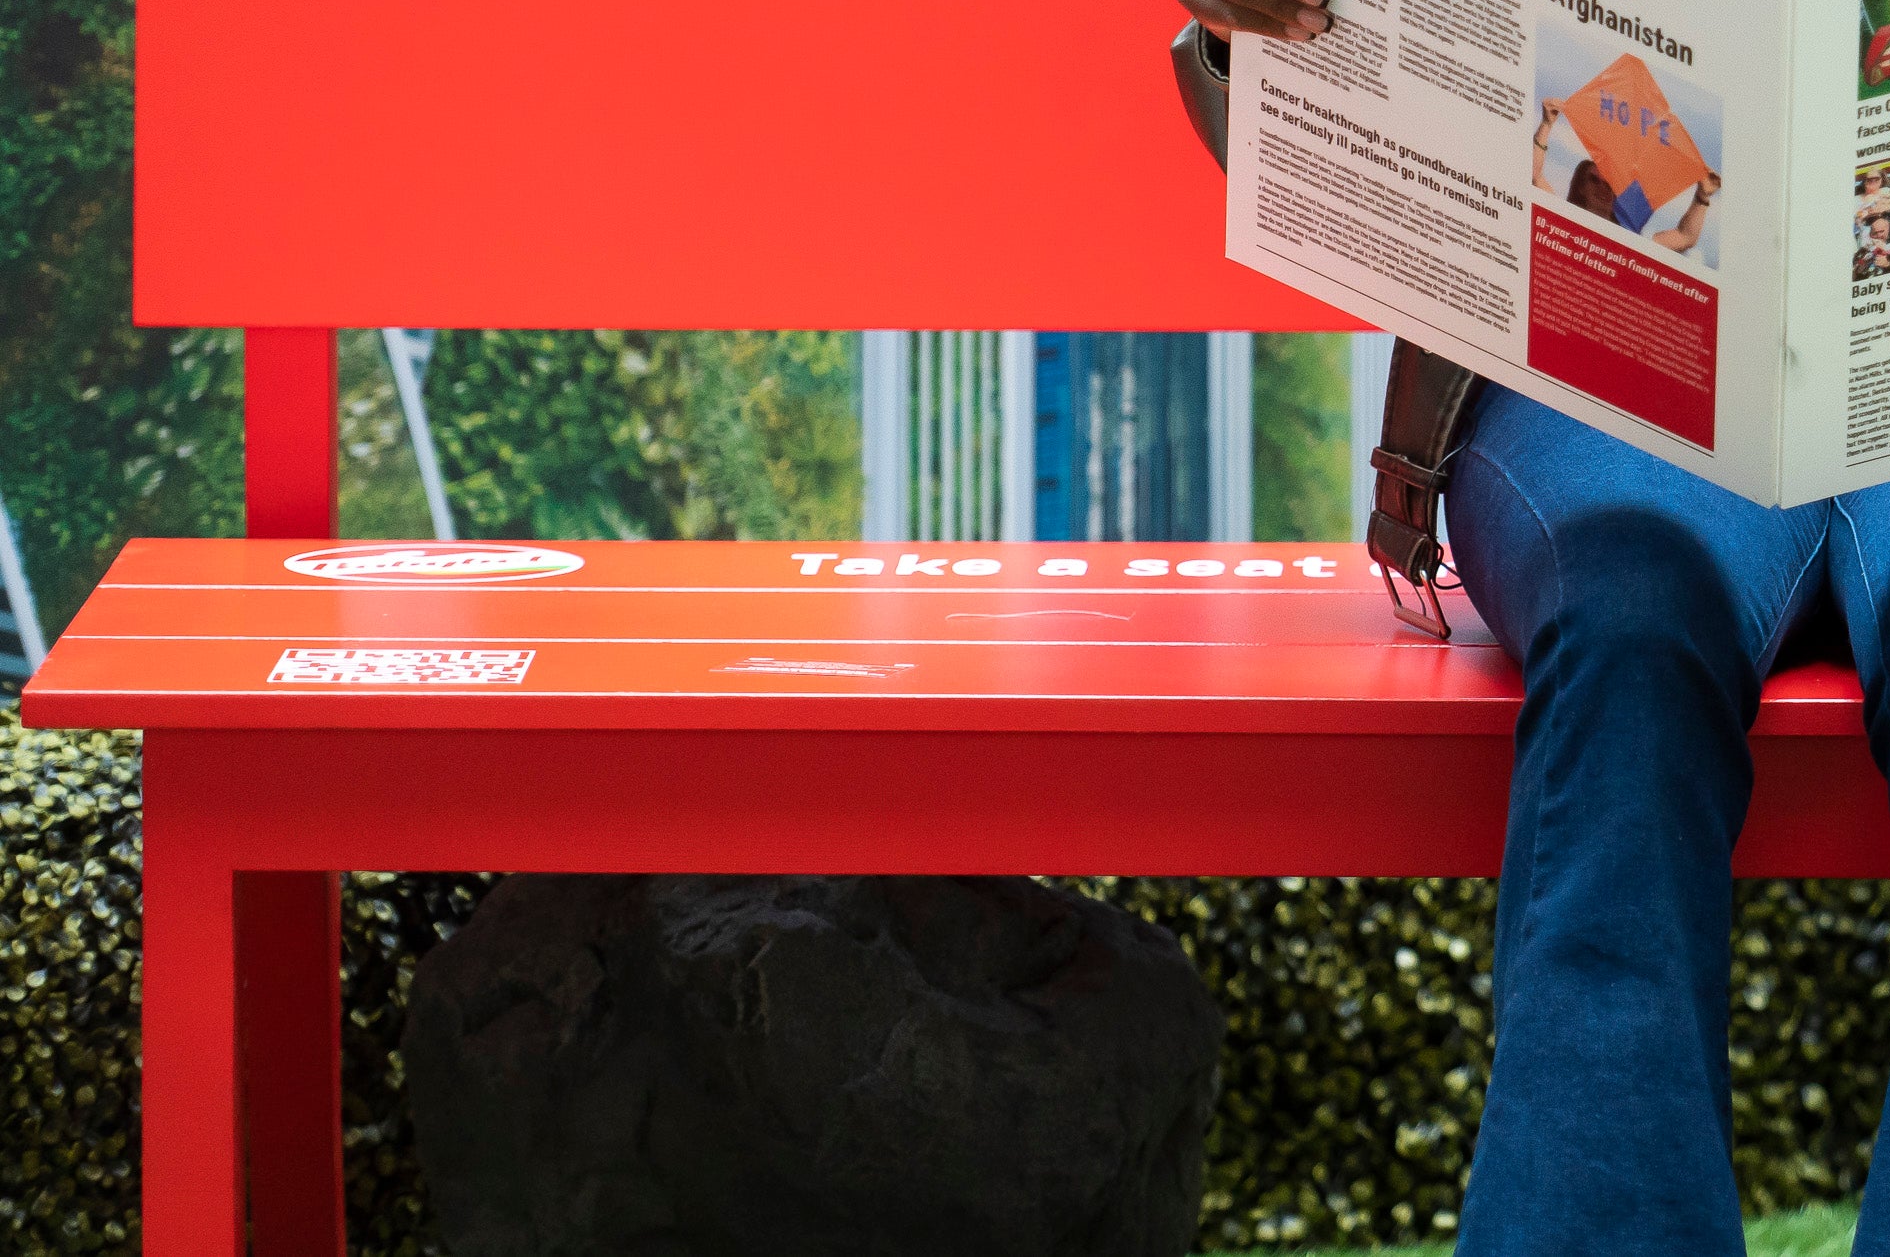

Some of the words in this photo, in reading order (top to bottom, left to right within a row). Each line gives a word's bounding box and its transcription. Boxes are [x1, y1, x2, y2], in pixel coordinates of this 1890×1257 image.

[1857, 104, 1882, 119] Fire
[1856, 121, 1890, 138] faces
[1261, 78, 1300, 106] Cancer
[1302, 97, 1380, 144] breakthrough
[1383, 137, 1395, 151] as
[1398, 145, 1488, 197] groundbreaking
[1491, 186, 1523, 210] trials
[1260, 101, 1279, 117] see
[1281, 111, 1333, 144] seriously
[1336, 133, 1347, 149] ill
[1350, 142, 1398, 172] patients
[1400, 166, 1414, 180] go
[1417, 170, 1440, 192] into
[1443, 186, 1498, 219] remission
[1535, 231, 1572, 256] lifetime
[1573, 252, 1584, 261] of
[1584, 254, 1616, 277] letters
[1588, 243, 1606, 256] pen
[1606, 251, 1626, 265] pals
[1627, 258, 1659, 282] finally
[1659, 275, 1683, 292] meet
[1683, 287, 1708, 303] after
[1851, 282, 1883, 298] Baby
[1851, 301, 1886, 317] being
[791, 553, 1002, 576] Take
[1037, 558, 1088, 576] a
[1123, 556, 1337, 578] seat
